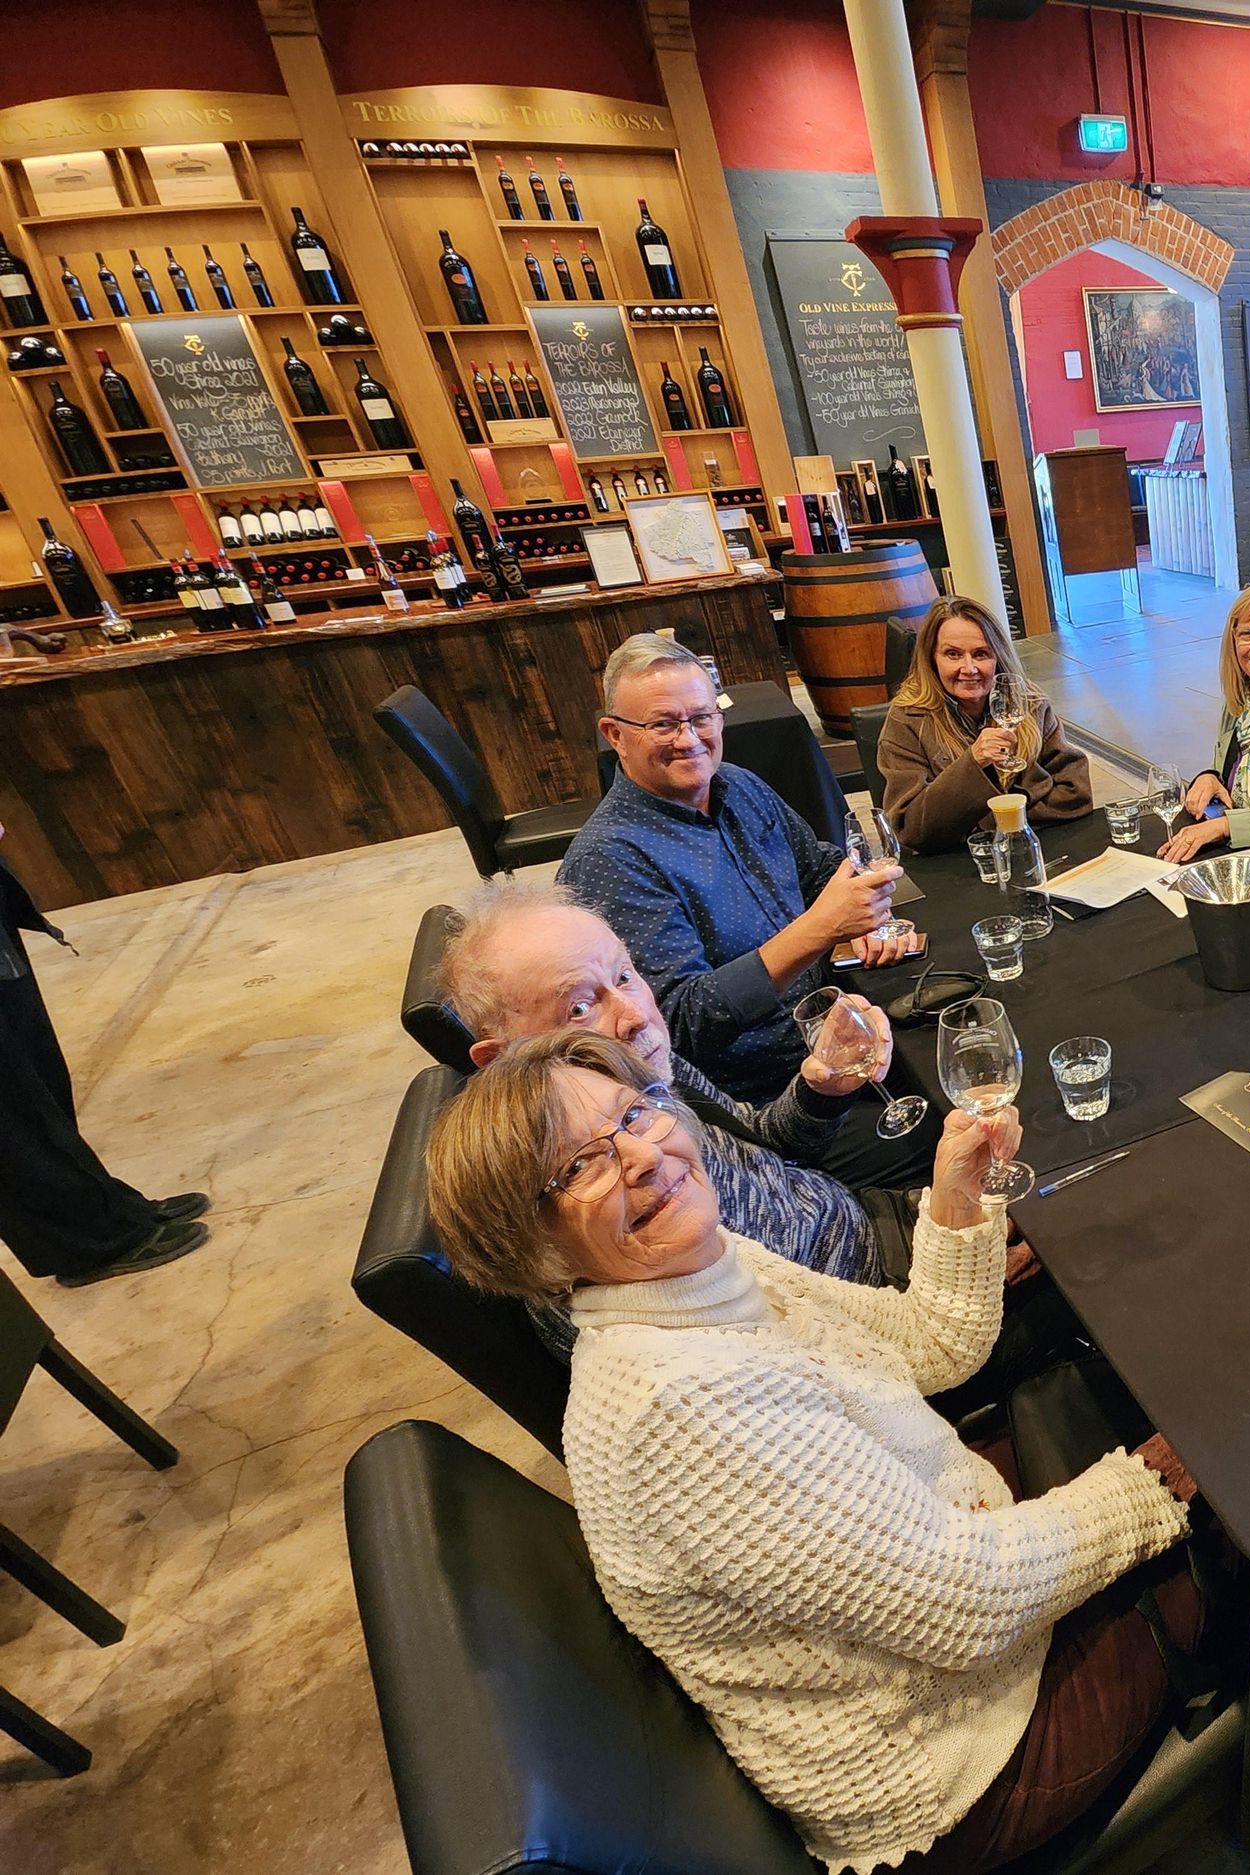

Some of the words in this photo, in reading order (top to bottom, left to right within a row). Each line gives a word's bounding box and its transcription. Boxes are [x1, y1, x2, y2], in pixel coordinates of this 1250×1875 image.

[799, 302, 822, 313] OLD
[823, 303, 850, 313] VINE
[542, 341, 599, 362] TERROIRS
[601, 342, 616, 357] OF
[151, 357, 176, 378] 50
[174, 361, 201, 385] year
[202, 351, 224, 372] old
[554, 361, 578, 377] THE
[579, 357, 632, 378] BAROSSA
[222, 371, 259, 387] 2021
[176, 422, 199, 438] 50
